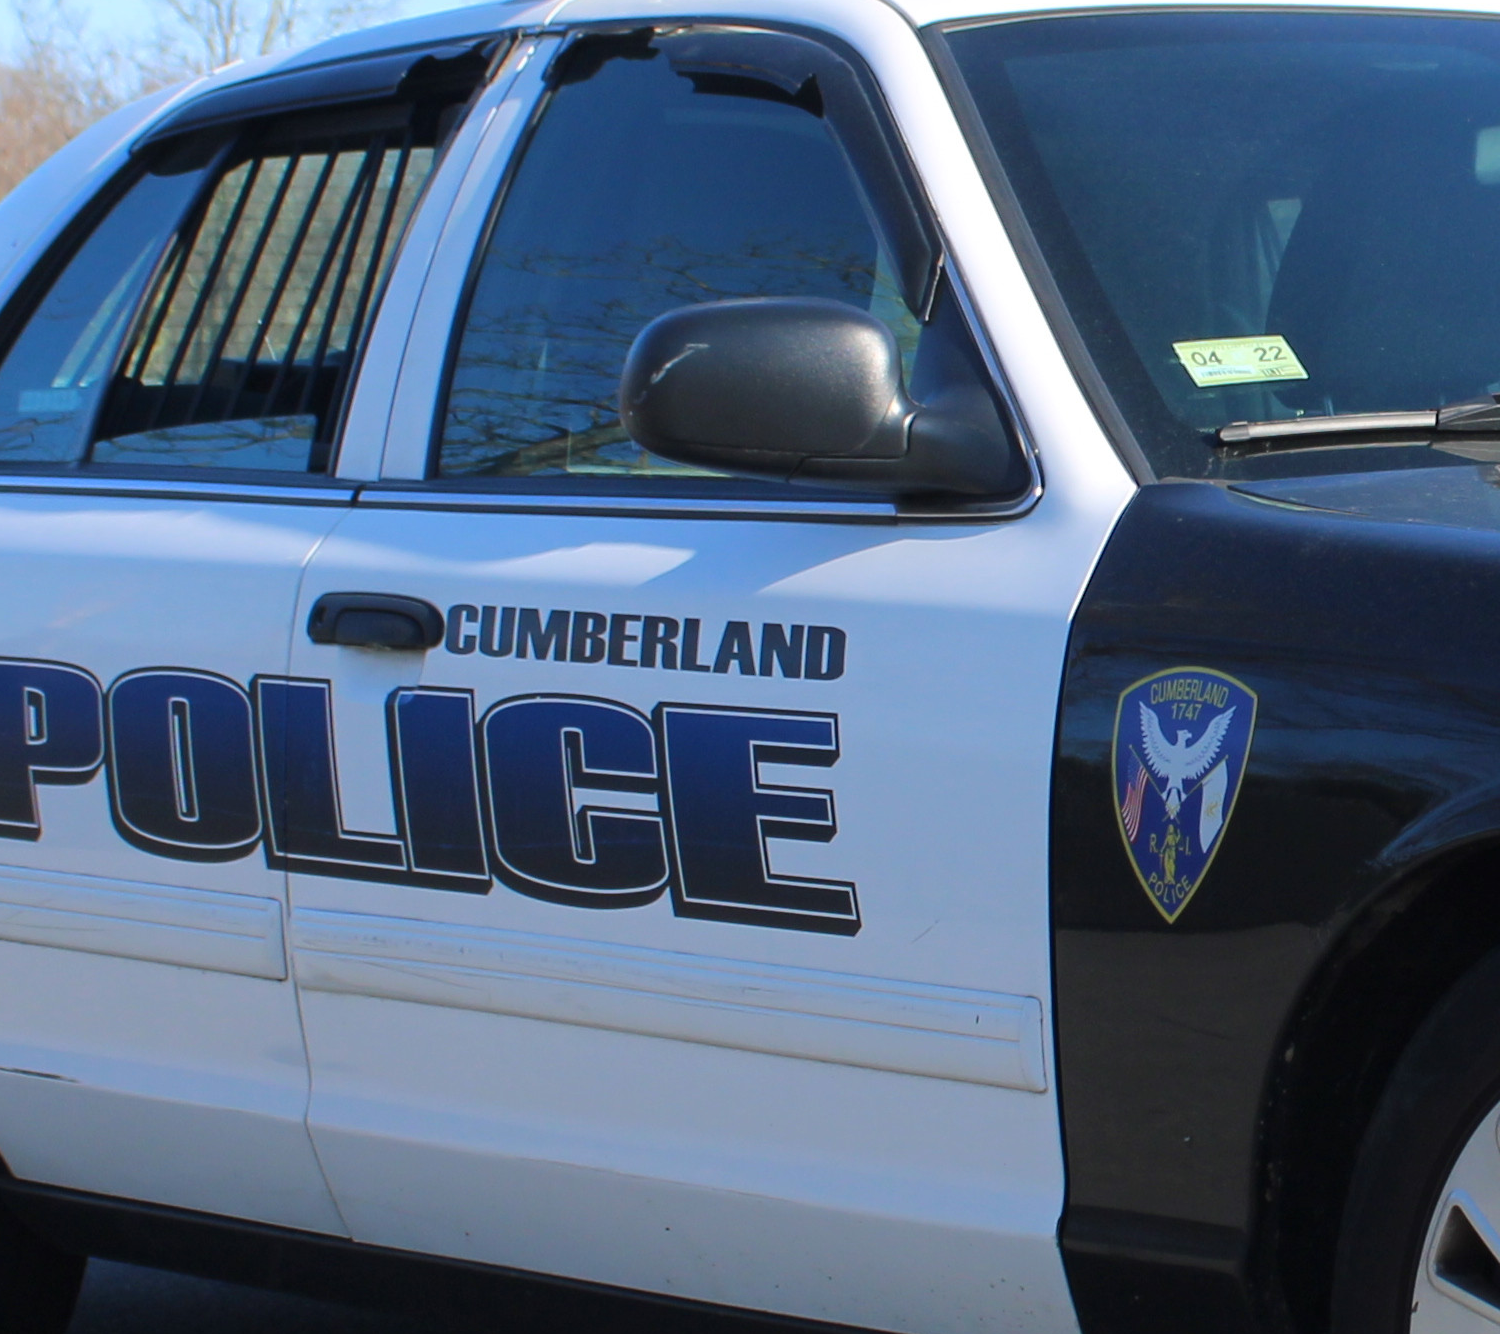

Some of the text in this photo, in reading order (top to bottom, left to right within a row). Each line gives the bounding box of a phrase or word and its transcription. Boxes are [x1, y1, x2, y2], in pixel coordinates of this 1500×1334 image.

[1191, 351, 1222, 367] 04
[1253, 346, 1287, 363] 22
[445, 603, 847, 681] CUMBERLAND
[1150, 678, 1229, 709] CUMBERLAND
[1171, 702, 1202, 720] 1747
[1148, 871, 1192, 904] POLICE
